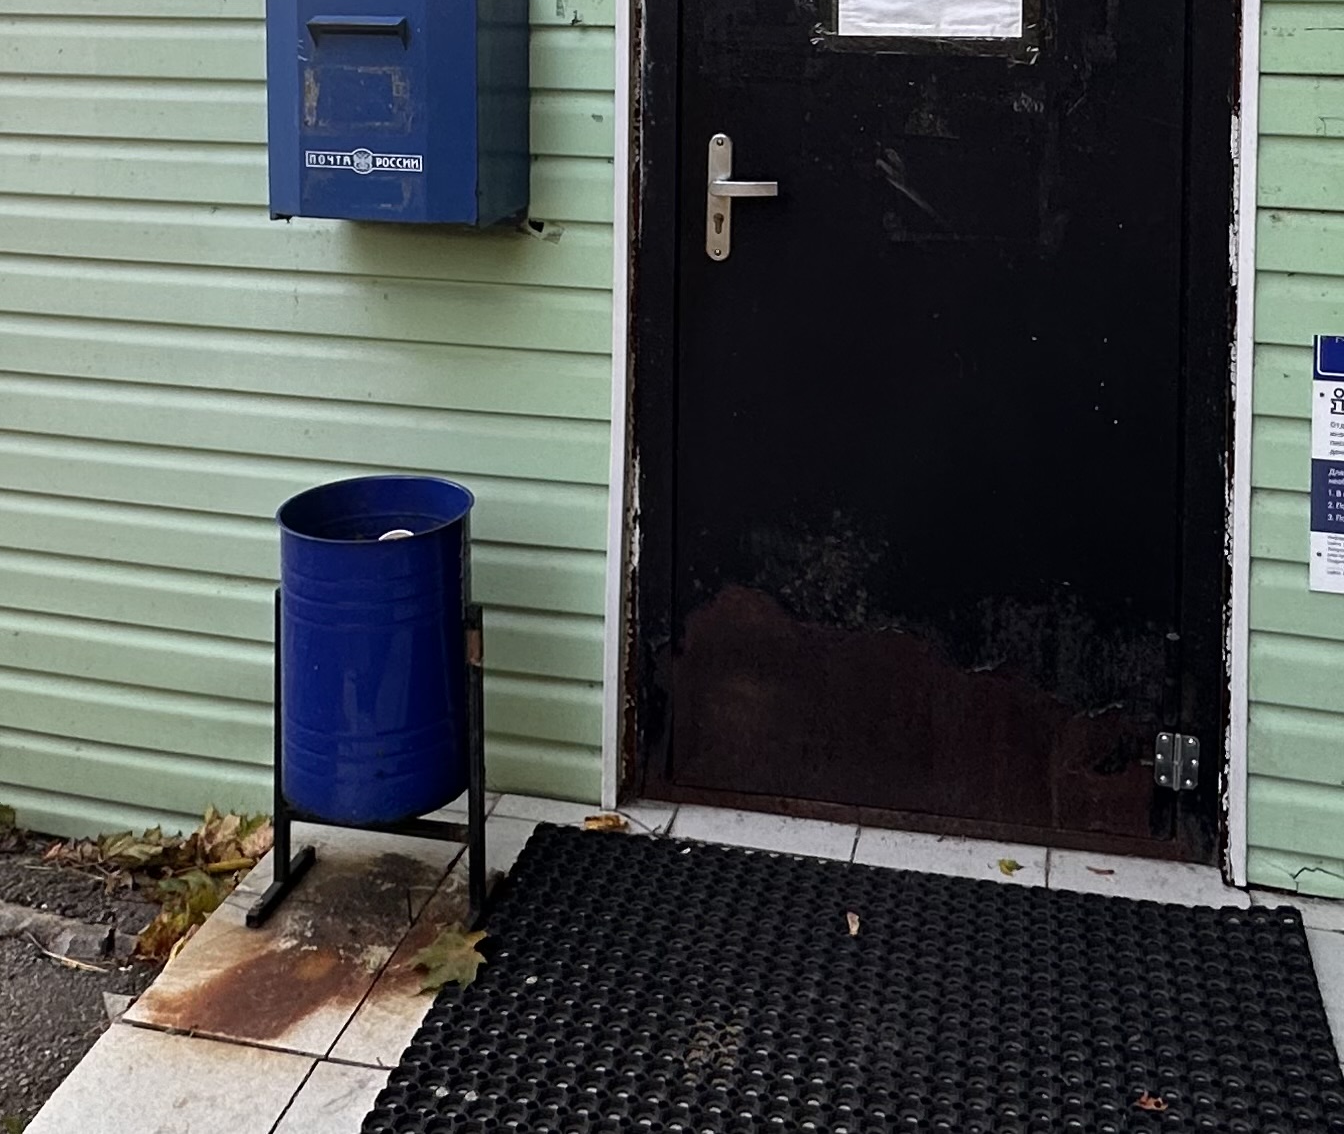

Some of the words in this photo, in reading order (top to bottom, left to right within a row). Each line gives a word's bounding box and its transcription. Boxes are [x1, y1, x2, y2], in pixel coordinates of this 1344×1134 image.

[309, 154, 352, 166] ПОЧТА
[375, 156, 419, 169] РОССИИ
[1328, 468, 1344, 477] Для
